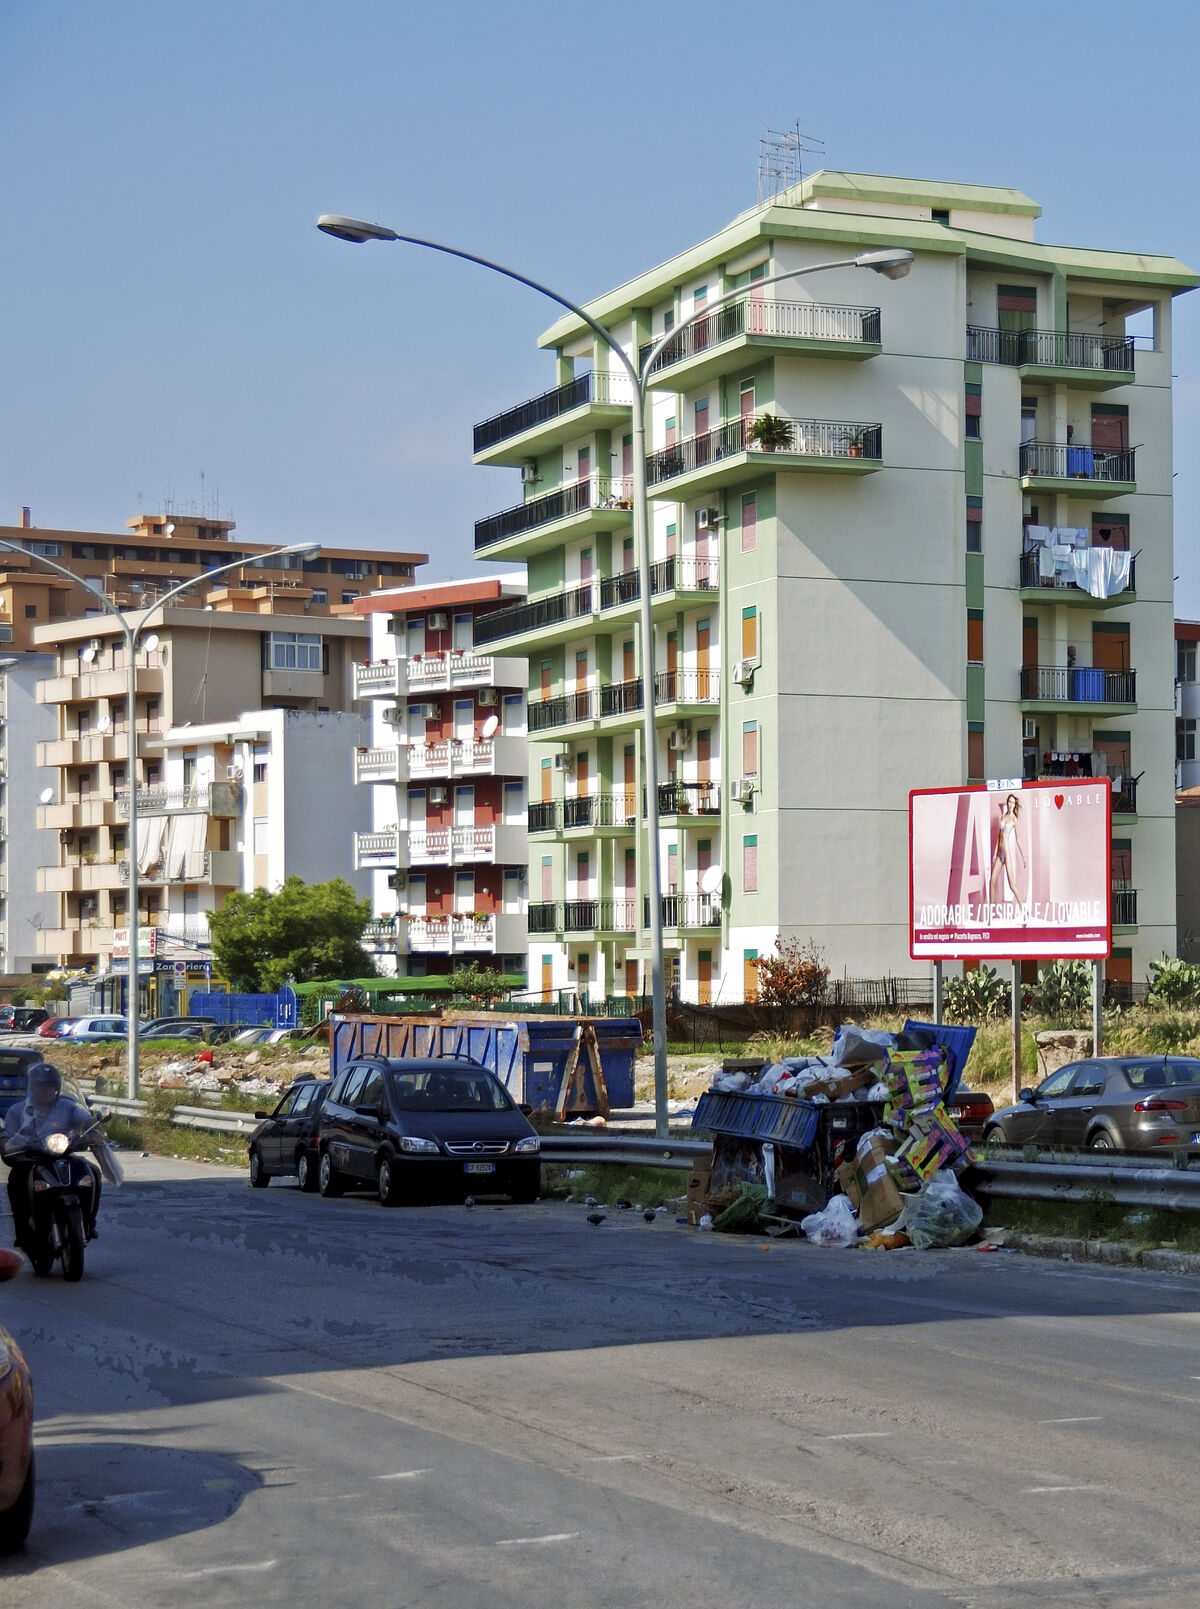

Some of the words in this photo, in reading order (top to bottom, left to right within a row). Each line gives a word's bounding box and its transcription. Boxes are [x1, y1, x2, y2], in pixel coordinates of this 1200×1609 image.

[920, 903, 974, 926] ADORABLE
[983, 901, 1041, 924] DESIRABLE
[1052, 901, 1100, 923] LOVABLE
